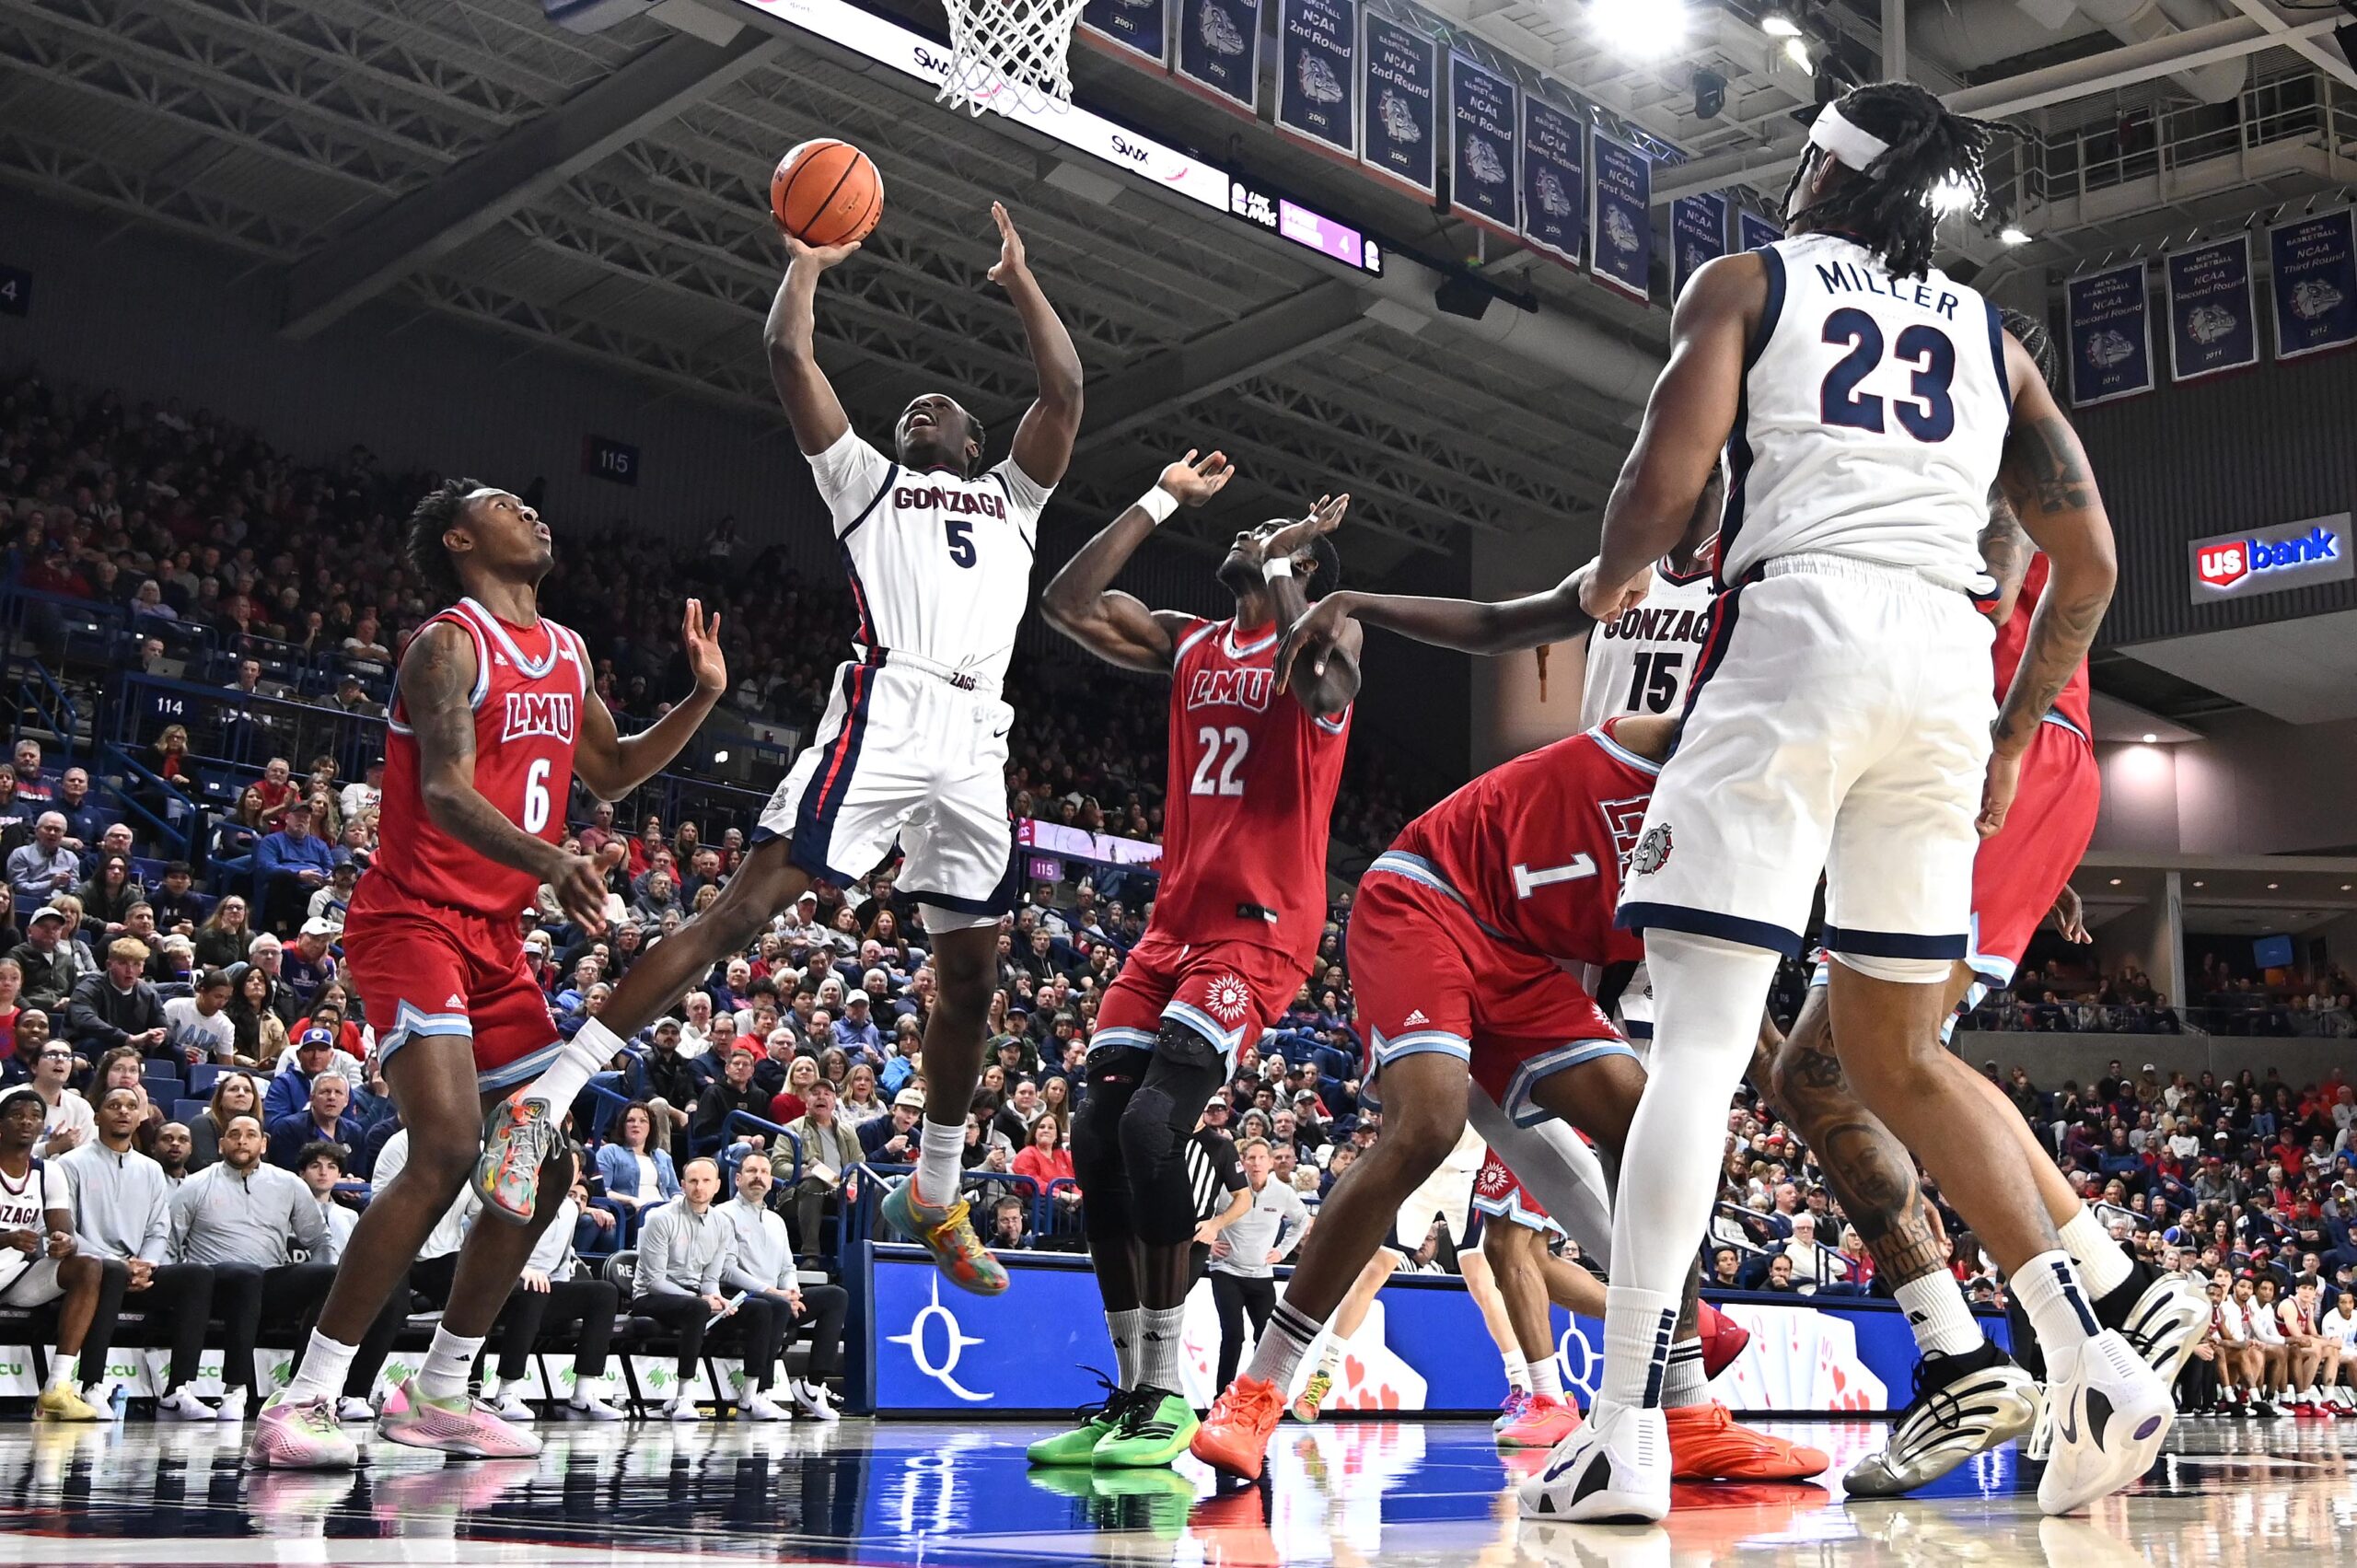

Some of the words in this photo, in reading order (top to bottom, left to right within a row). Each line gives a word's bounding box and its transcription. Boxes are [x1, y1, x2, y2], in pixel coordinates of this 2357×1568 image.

[1114, 16, 1134, 31] 2001
[1303, 9, 1336, 35] NCAA
[1290, 19, 1311, 39] 2nd
[1312, 31, 1351, 58] Round
[1384, 52, 1416, 75] NCAA
[1371, 62, 1392, 80] 2nd
[1394, 74, 1429, 99] Round
[1308, 112, 1326, 126] 2003
[1470, 96, 1498, 119] NCAA
[1457, 106, 1476, 124] 2nd
[1479, 117, 1512, 141] Round
[1540, 131, 1567, 154] NCAA
[1552, 150, 1581, 174] Sixteen
[1608, 168, 1635, 192] NCAA
[1597, 178, 1620, 195] First
[1619, 189, 1645, 210] Round
[1686, 209, 1713, 229] NCAA
[1339, 235, 1350, 254] 4
[1678, 218, 1697, 236] First
[1696, 225, 1721, 247] Round
[2286, 228, 2338, 247] BASKETBALL
[2283, 261, 2309, 274] Third
[2312, 250, 2346, 267] Round
[2296, 243, 2330, 259] NCAA
[2183, 255, 2233, 273] BASKETBALL
[2175, 286, 2212, 302] Second
[2213, 275, 2247, 293] Round
[2194, 270, 2226, 287] NCAA
[1, 280, 17, 302] 4
[1815, 261, 1958, 321] MILLER
[2074, 311, 2109, 328] Second
[2111, 302, 2143, 319] Round
[2092, 296, 2122, 311] NCAA
[1820, 307, 1956, 443] 23
[601, 449, 629, 473] 115
[895, 486, 1007, 525] GONZAGA
[945, 520, 977, 569] 5
[2201, 549, 2242, 578] us
[2247, 527, 2336, 571] bank
[949, 671, 977, 692] ZAGS
[1187, 668, 1274, 713] LMU
[1626, 652, 1683, 714] 15
[157, 697, 183, 715] 114
[501, 692, 575, 745] LMU
[1190, 726, 1249, 796] 22
[523, 758, 552, 834] 6
[1036, 862, 1054, 876] 115
[1512, 850, 1598, 900] 1
[1404, 1016, 1430, 1027] adidas
[885, 1268, 995, 1401] Q
[1752, 1315, 1764, 1339] Q
[1821, 1335, 1833, 1361] 10
[197, 1365, 223, 1378] CC
